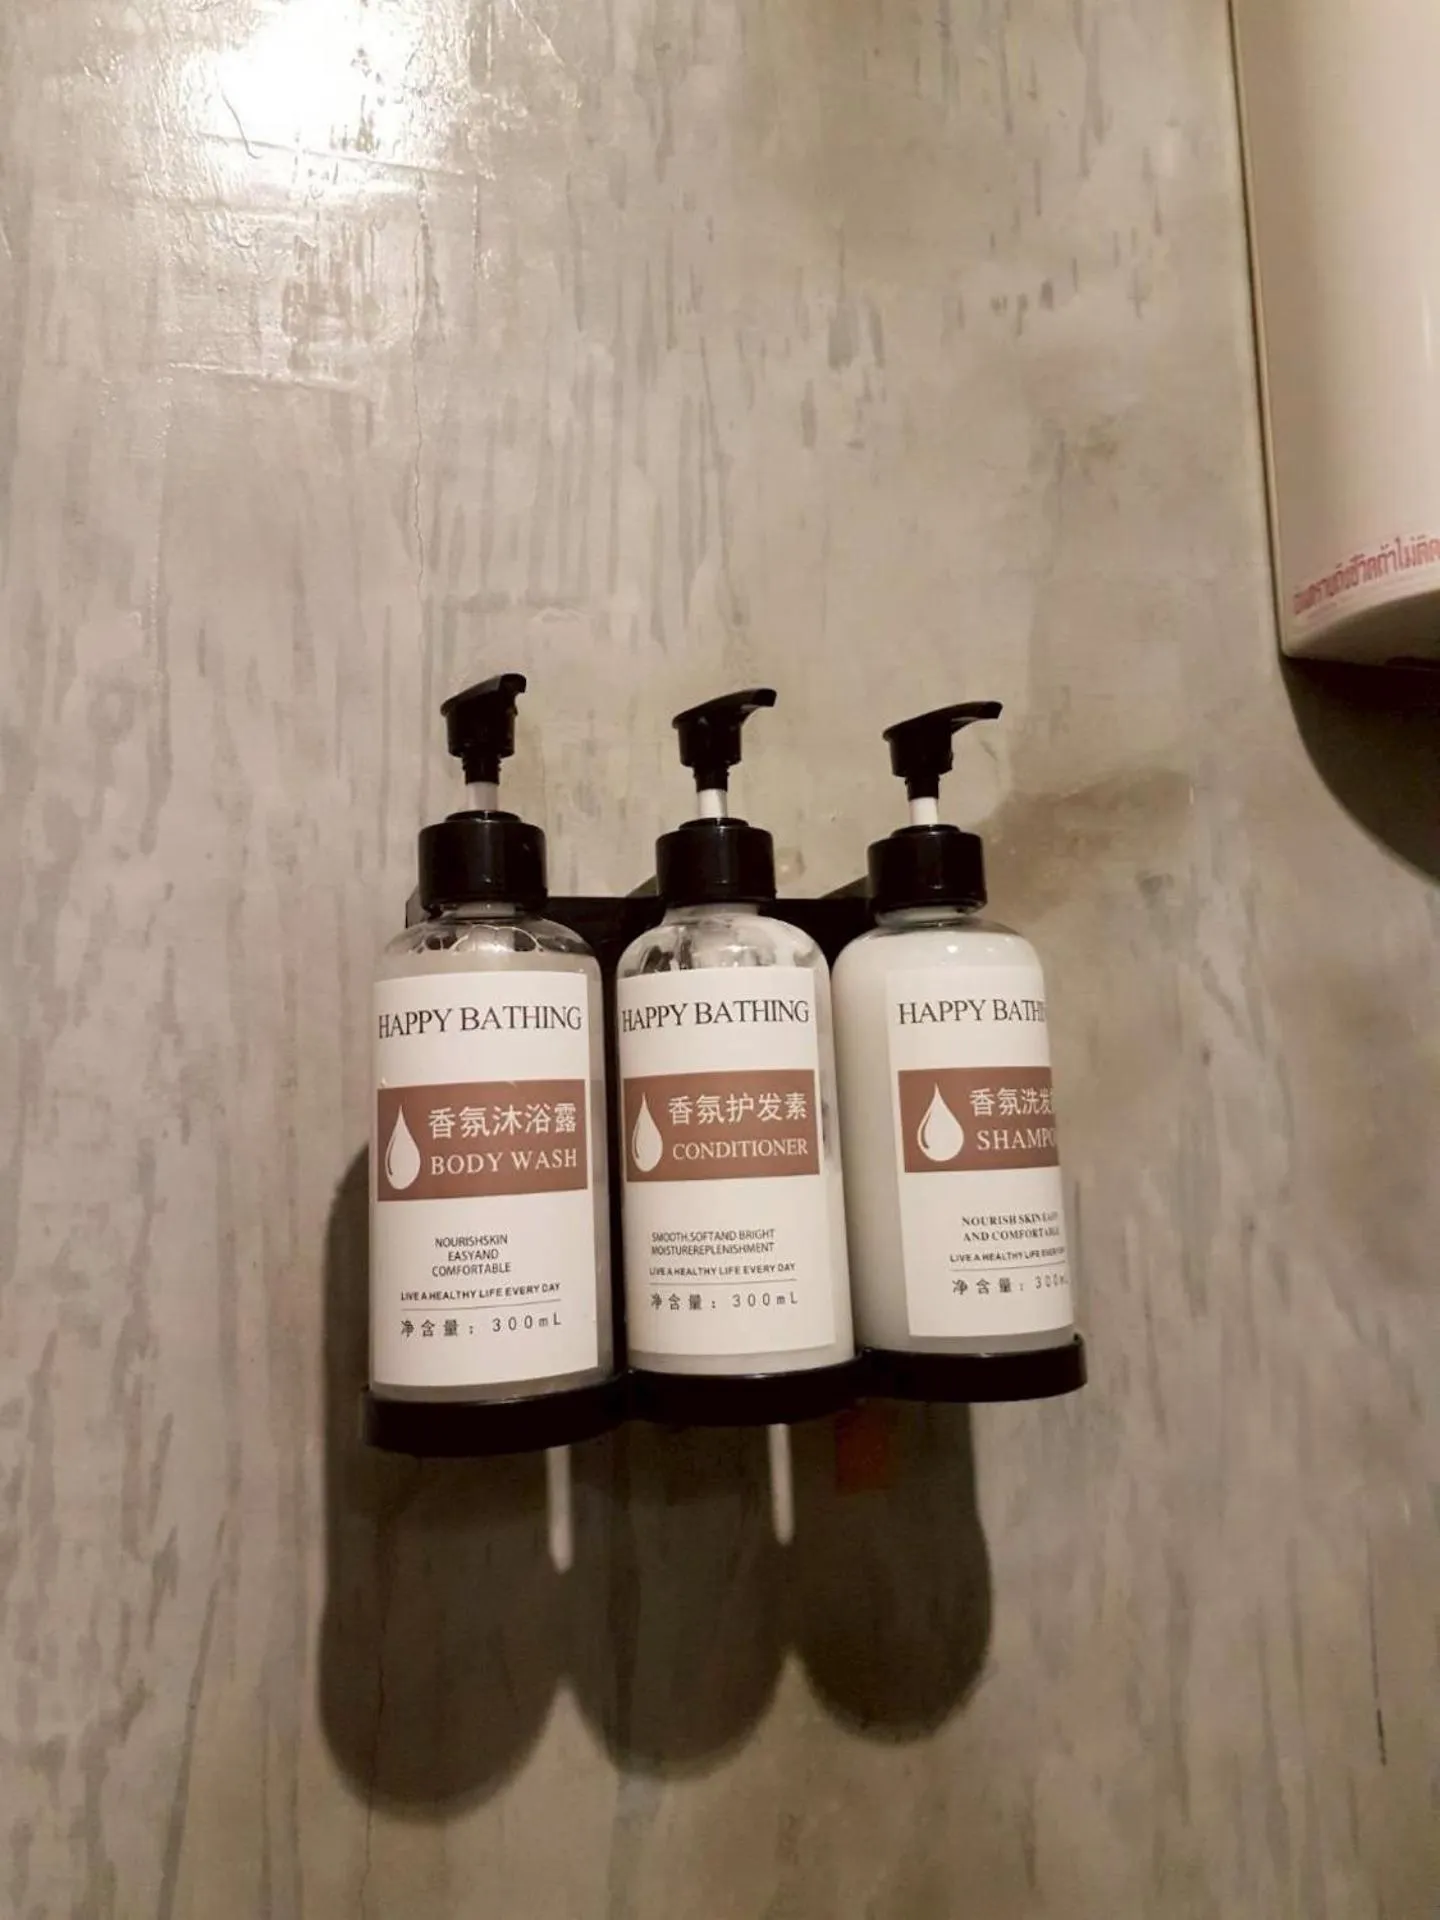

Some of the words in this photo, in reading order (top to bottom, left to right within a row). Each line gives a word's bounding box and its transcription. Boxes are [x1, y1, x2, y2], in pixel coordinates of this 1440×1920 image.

[378, 1008, 452, 1039] HAPPY
[460, 1005, 581, 1031] BATHING
[622, 1003, 688, 1032] HAPPY
[695, 999, 809, 1024] BATHING
[898, 1000, 985, 1024] HAPPY
[668, 1092, 808, 1124] 香氛护发素
[428, 1102, 576, 1139] 香氛沐浴露
[430, 1152, 502, 1175] BODY
[510, 1148, 577, 1169] WASH
[672, 1139, 808, 1160] CONDITIONER
[739, 1228, 775, 1240] BRIGHT
[432, 1262, 511, 1277] COMFORTABLE
[732, 1291, 798, 1308] 300mL
[492, 1312, 561, 1332] 300mL
